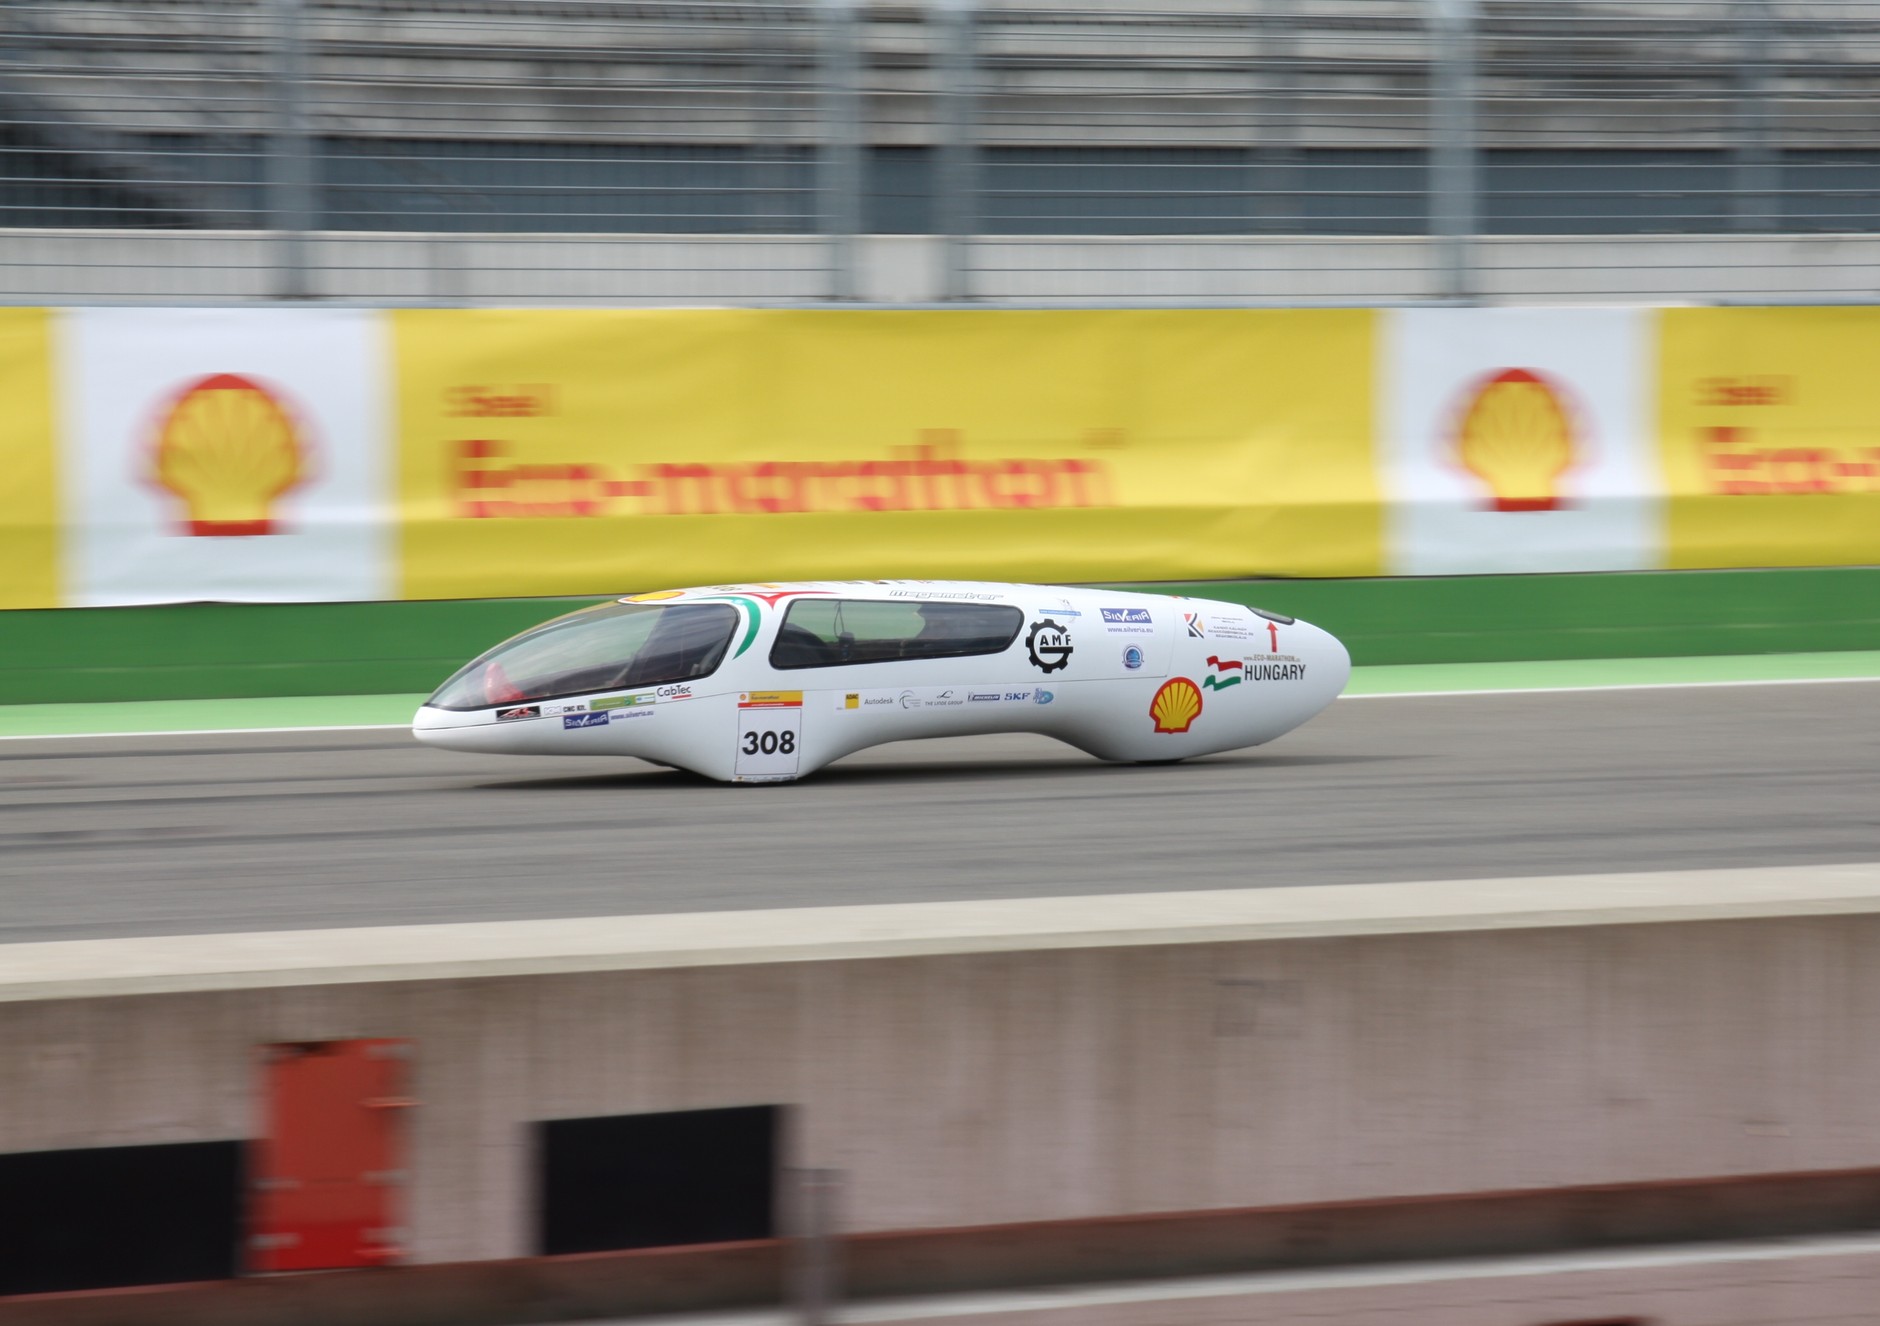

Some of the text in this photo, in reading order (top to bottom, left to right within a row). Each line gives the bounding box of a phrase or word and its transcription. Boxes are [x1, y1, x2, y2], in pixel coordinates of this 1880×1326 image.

[1244, 664, 1306, 681] HUNGARY
[657, 685, 692, 697] CabTec
[1004, 692, 1031, 700] SKF
[864, 697, 893, 705] Autodesk
[742, 730, 795, 756] 308
